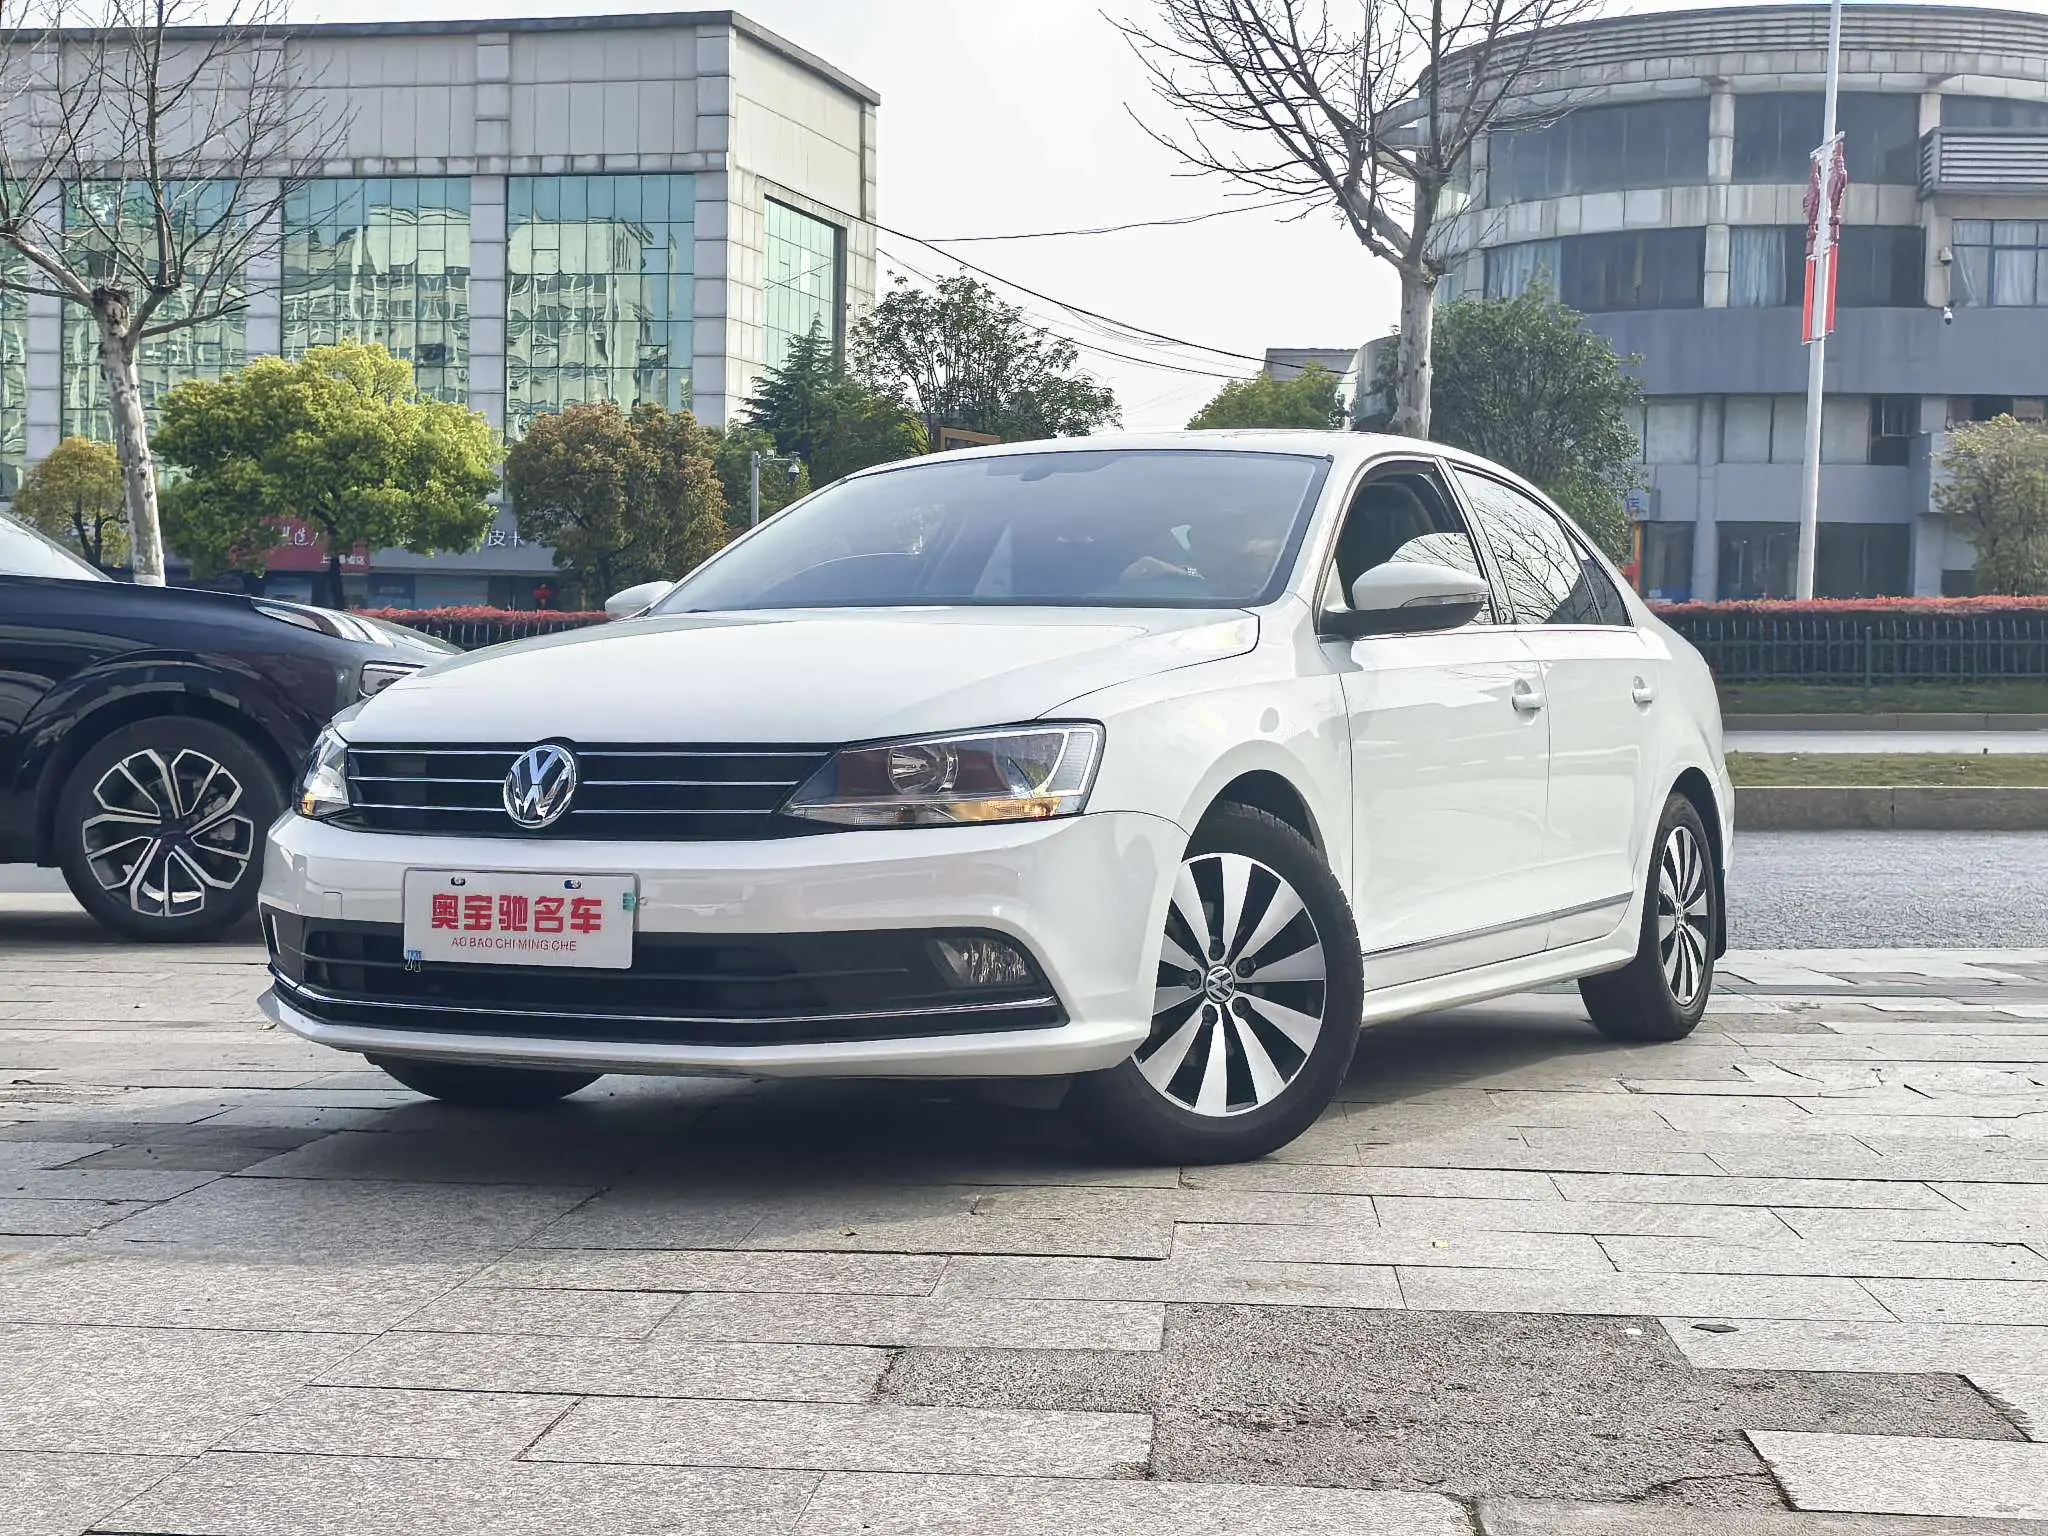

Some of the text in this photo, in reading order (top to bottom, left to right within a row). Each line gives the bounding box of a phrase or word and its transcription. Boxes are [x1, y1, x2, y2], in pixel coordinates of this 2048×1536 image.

[431, 893, 602, 934] 奥宝驰名车
